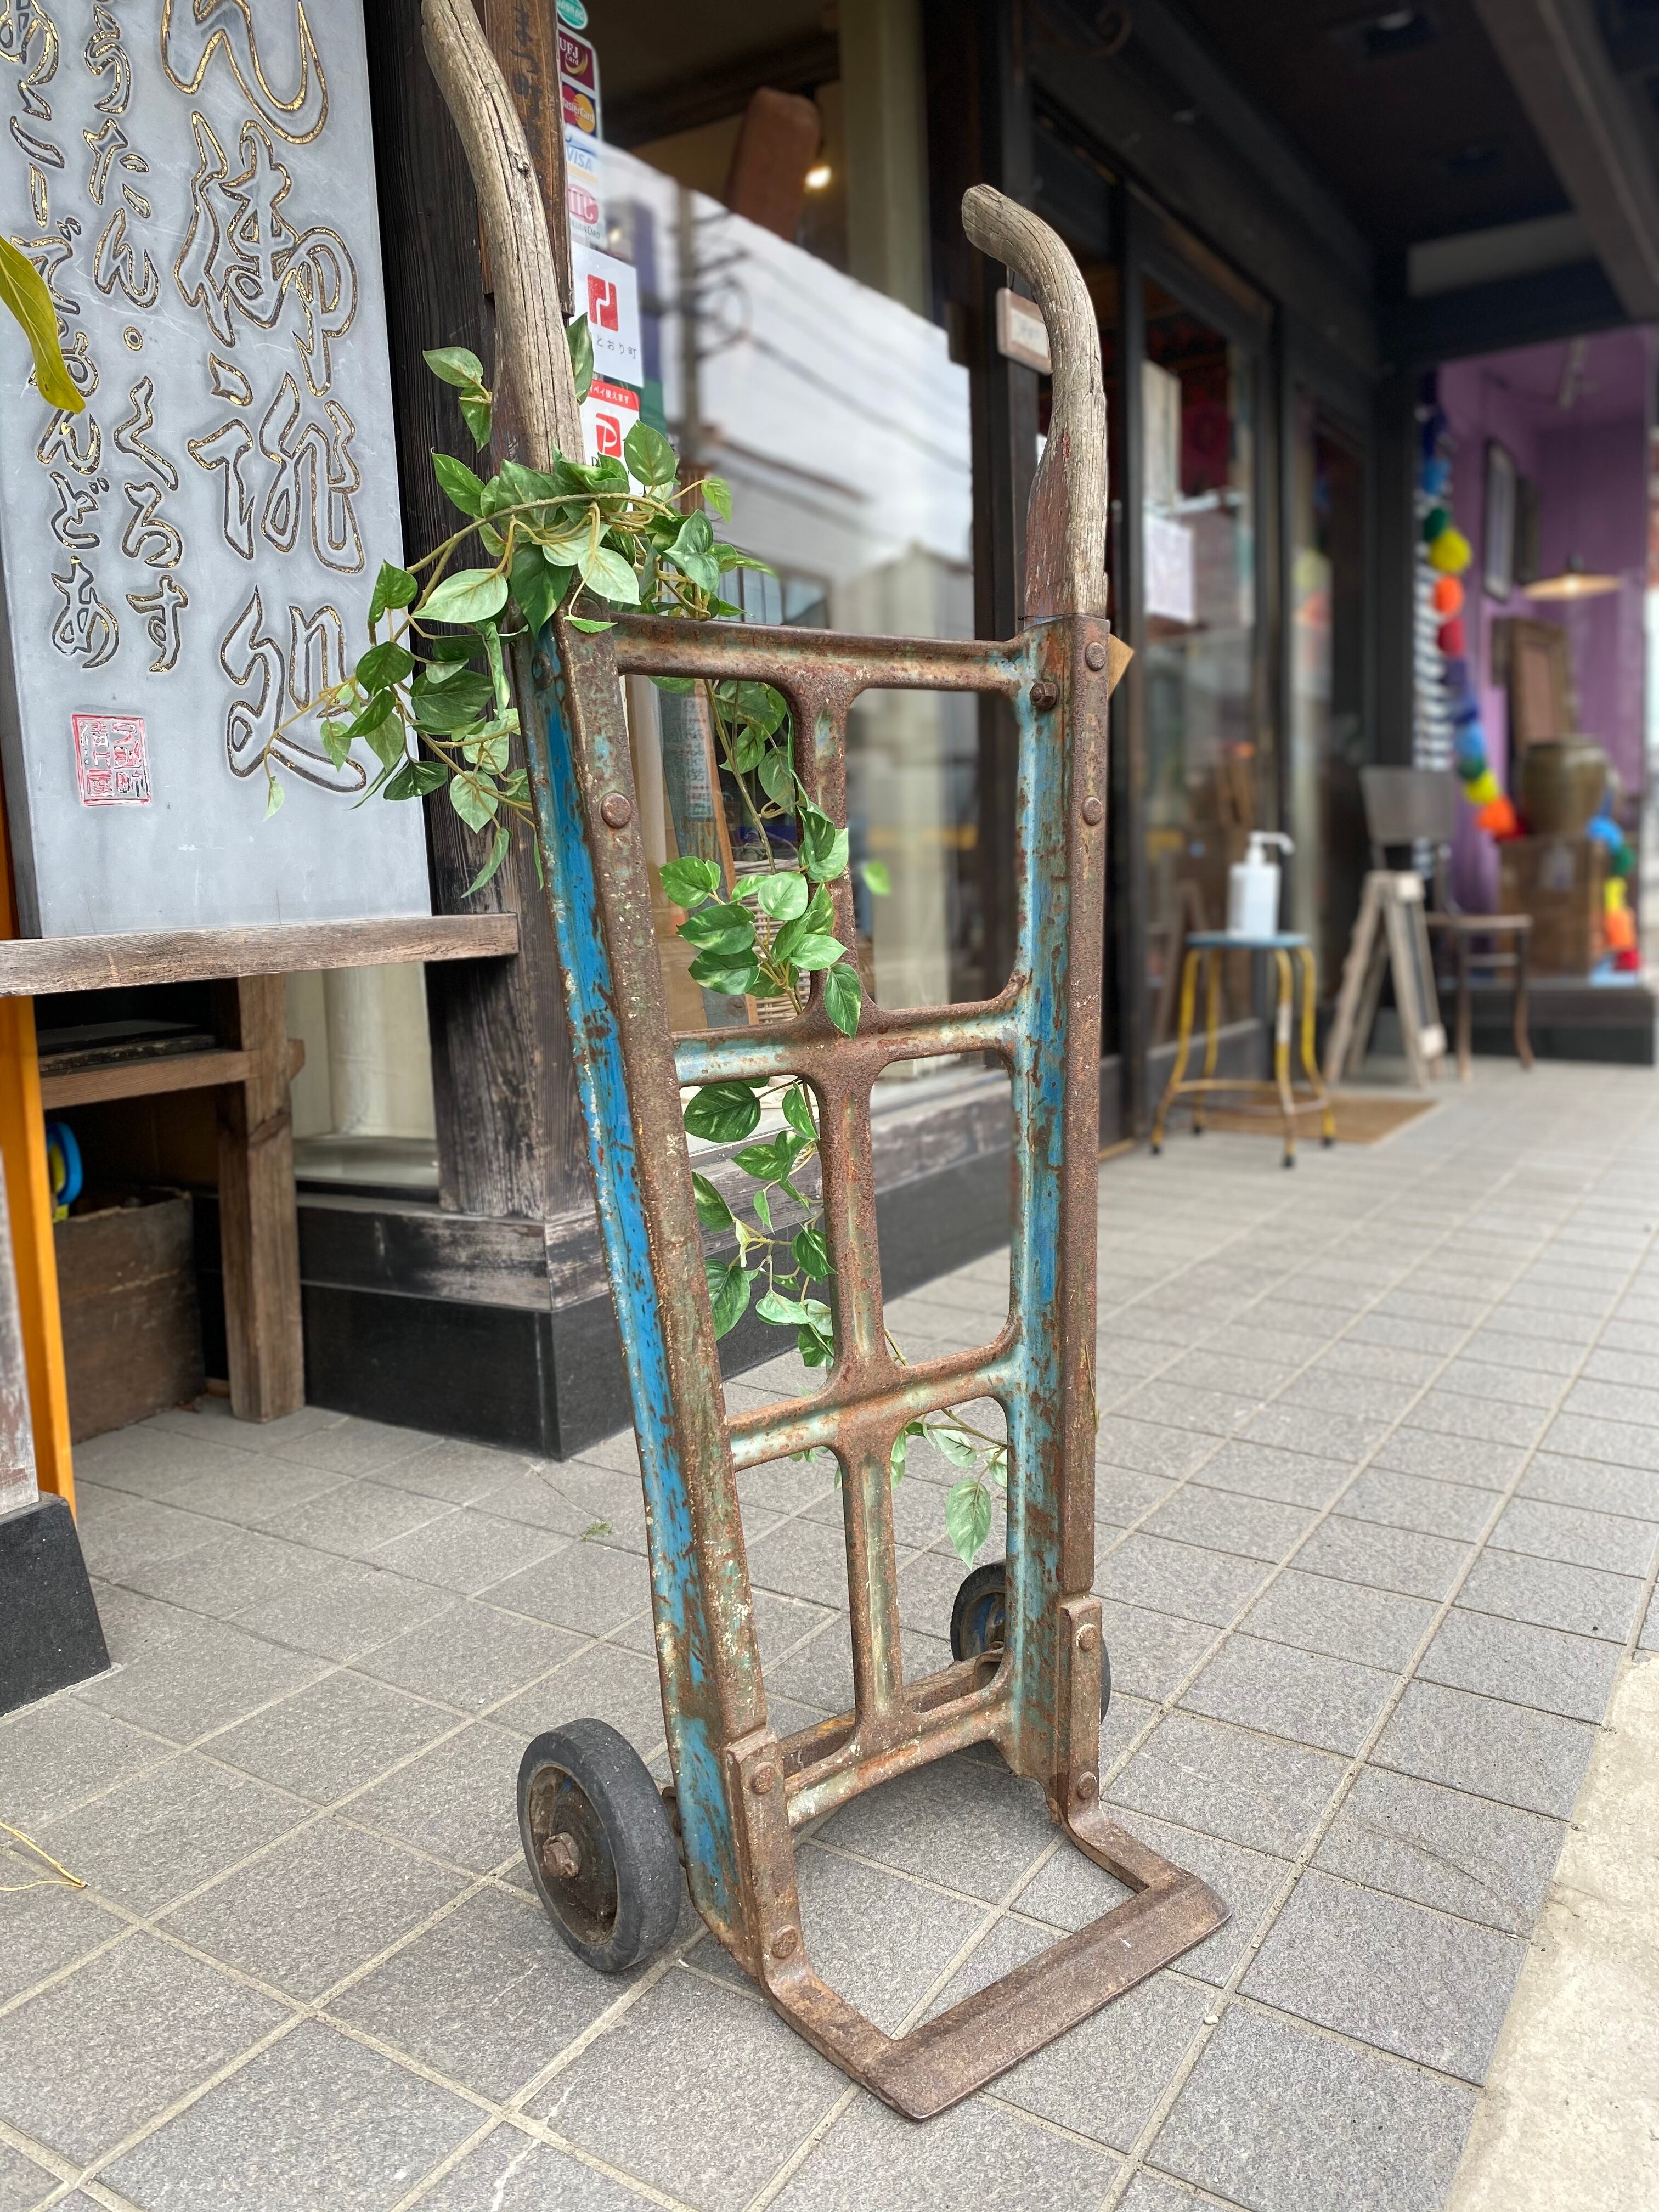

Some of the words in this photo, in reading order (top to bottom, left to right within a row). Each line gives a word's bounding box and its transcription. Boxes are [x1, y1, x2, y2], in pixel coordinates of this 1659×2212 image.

[559, 37, 579, 58] UFJ
[565, 53, 579, 66] Card
[563, 97, 594, 123] asterCard
[566, 146, 594, 172] VISA
[597, 335, 637, 359] とおり町
